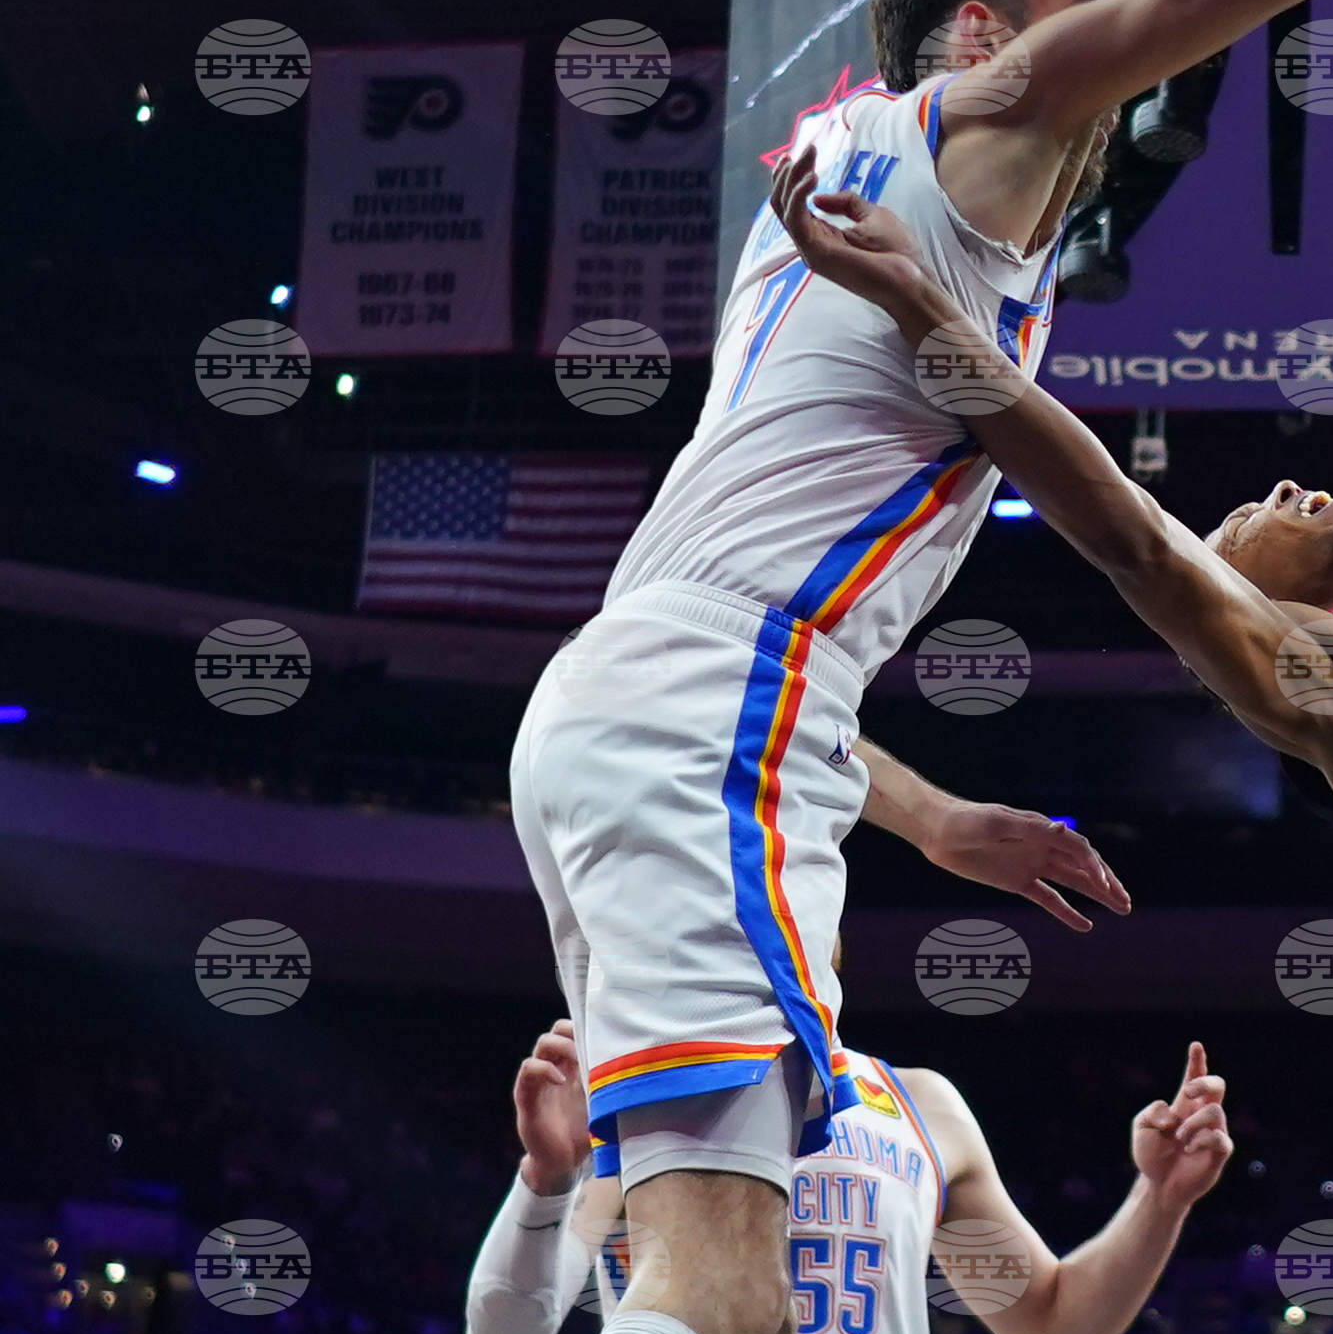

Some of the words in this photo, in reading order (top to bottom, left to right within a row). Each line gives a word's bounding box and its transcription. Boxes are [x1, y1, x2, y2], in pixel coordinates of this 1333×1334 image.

[603, 169, 710, 190] PATRICK
[353, 193, 465, 215] DIVISION
[330, 218, 484, 244] CHAMPIONS
[581, 222, 716, 247] CHAMPION
[790, 1170, 881, 1227] CITY
